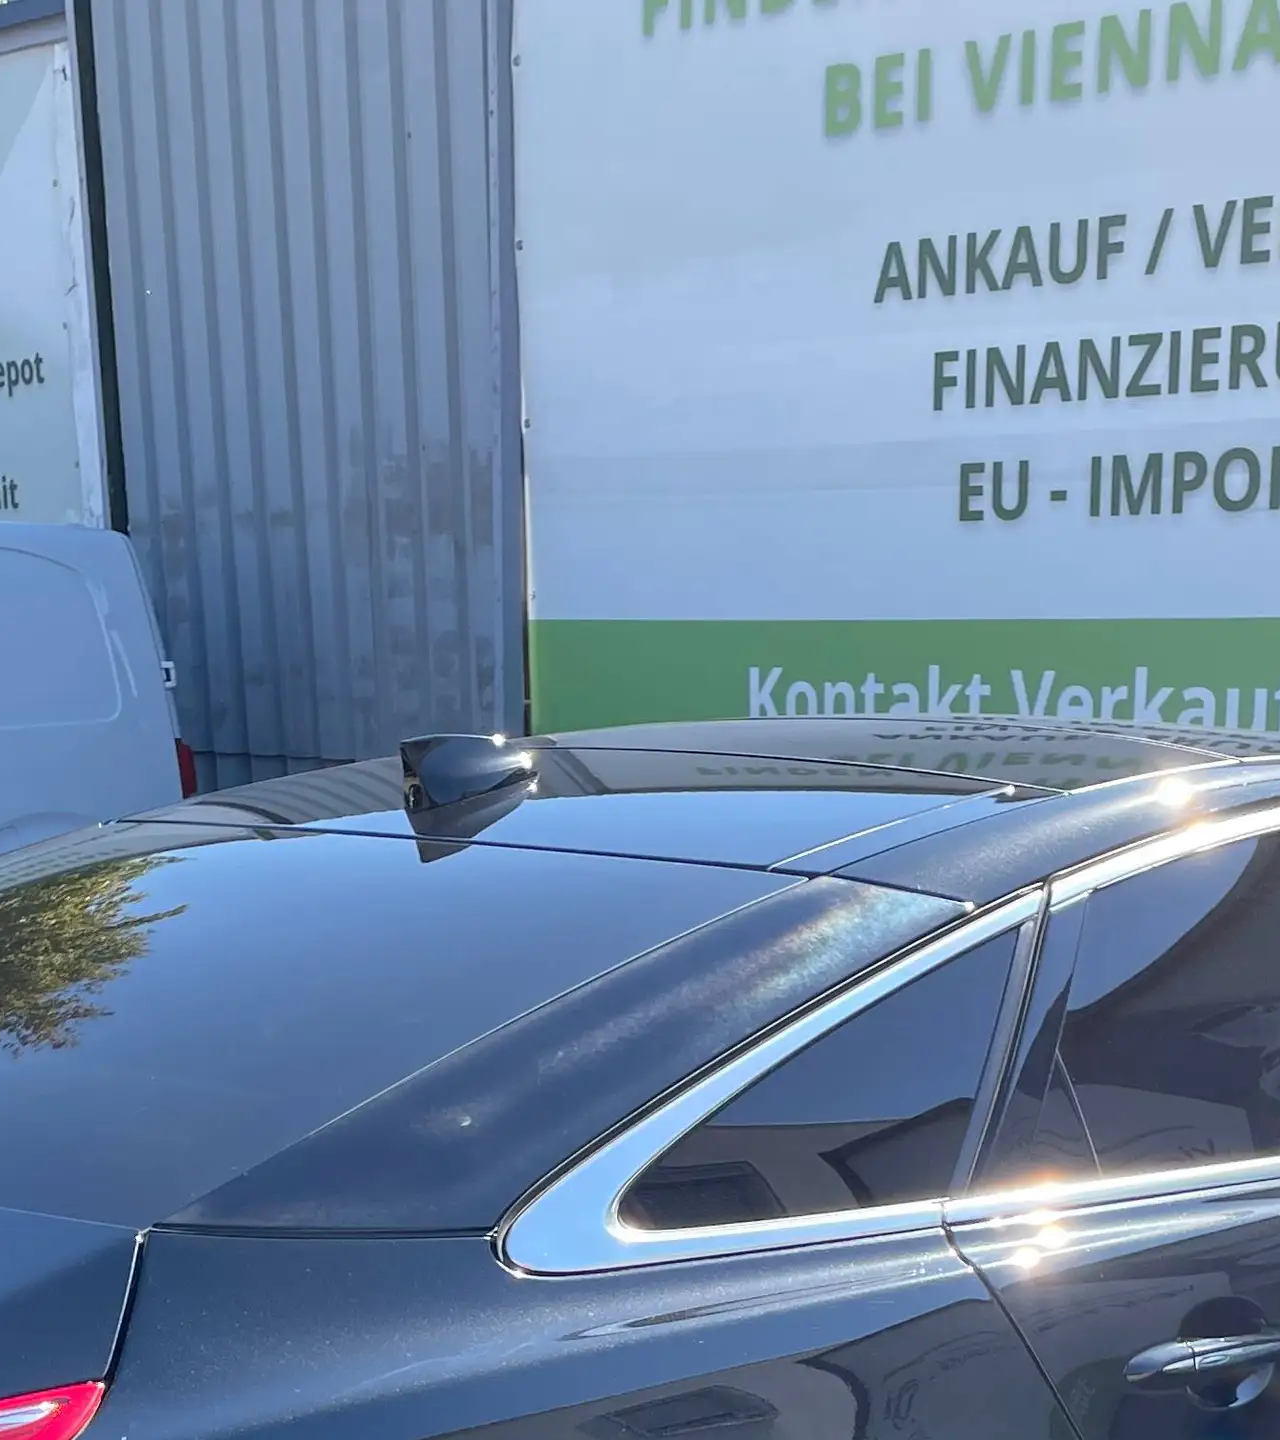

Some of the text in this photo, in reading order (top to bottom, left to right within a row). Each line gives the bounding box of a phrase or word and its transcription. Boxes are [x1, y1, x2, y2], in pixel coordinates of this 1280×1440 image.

[823, 47, 933, 138] BEI
[874, 213, 1127, 303] ANKAUF
[1144, 208, 1174, 275] /
[956, 459, 1030, 523] EU
